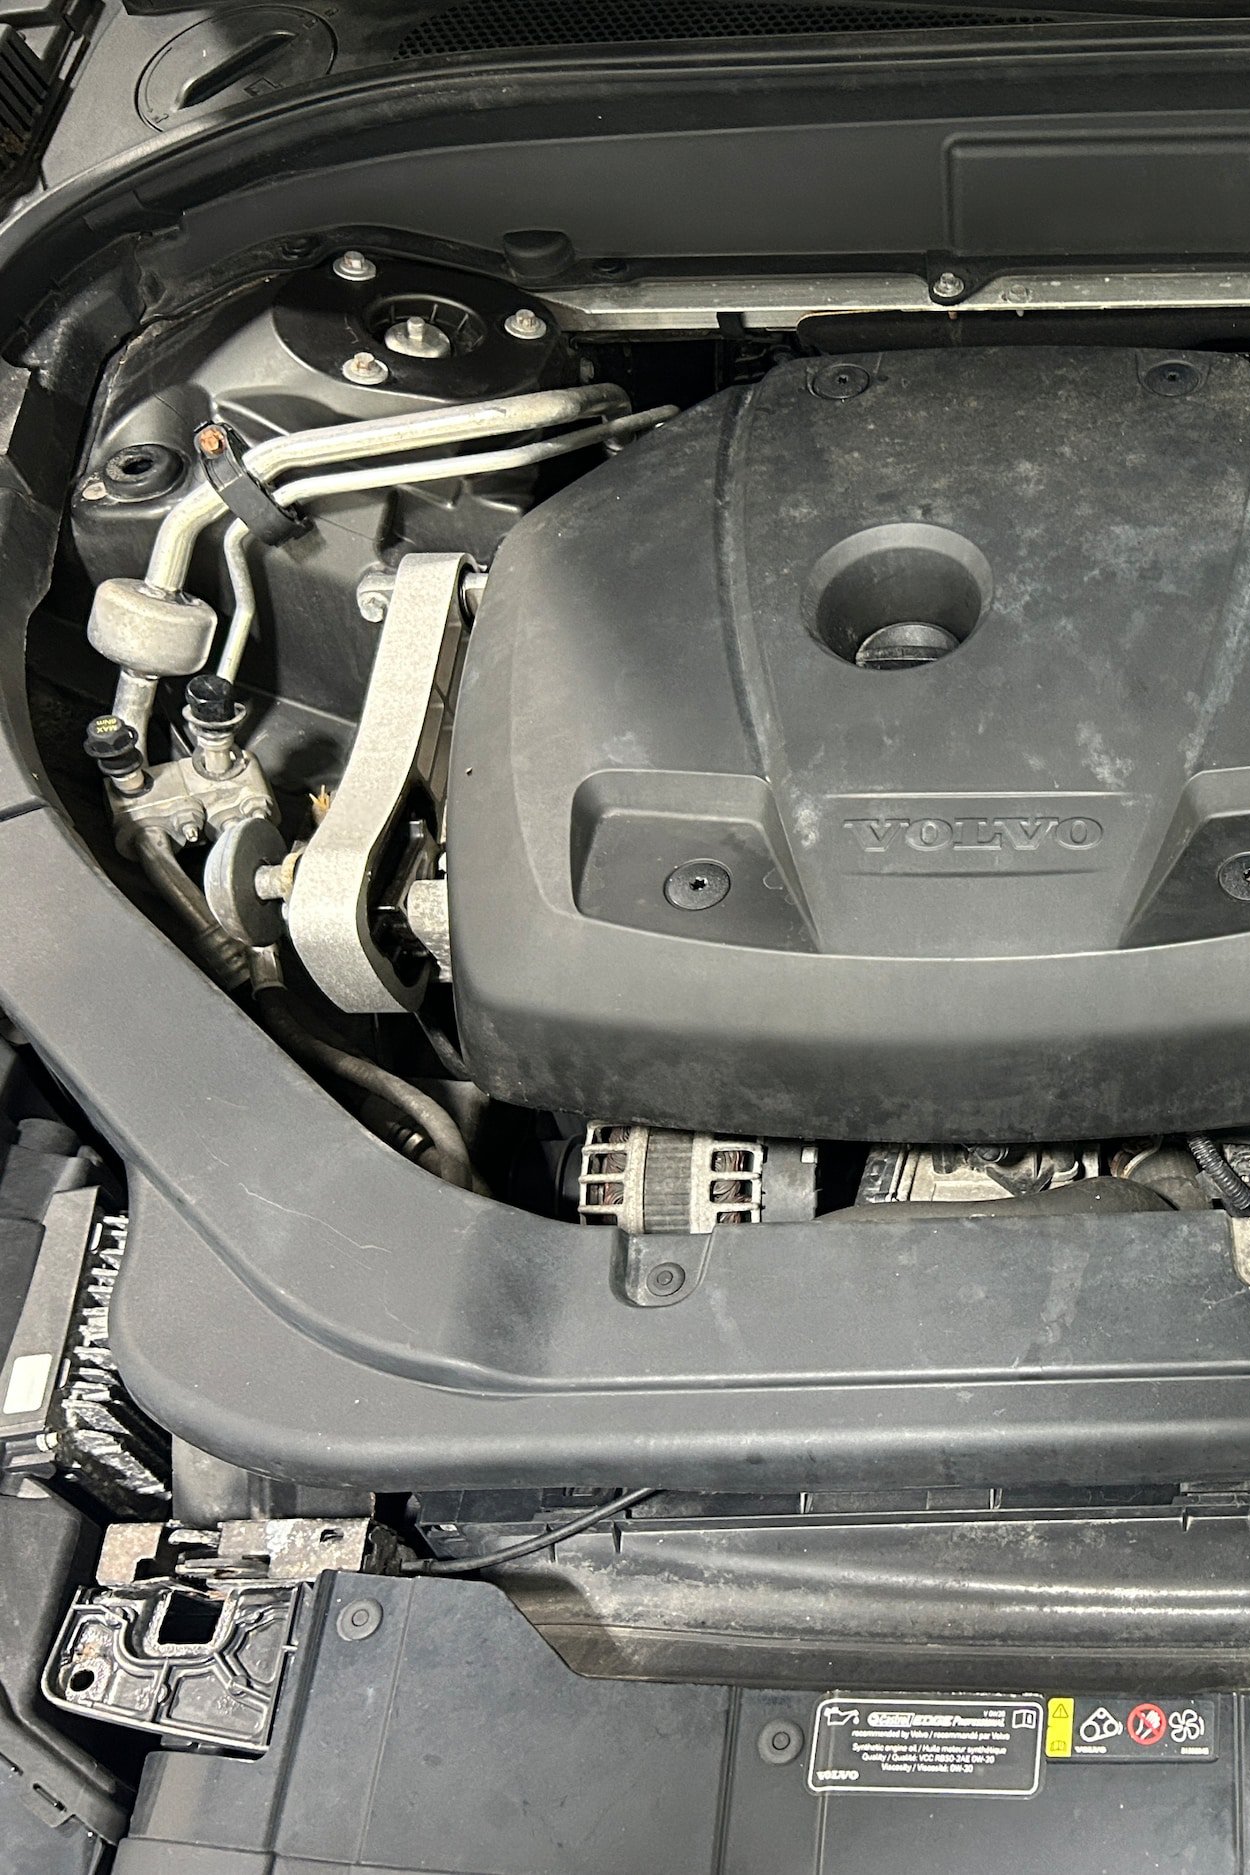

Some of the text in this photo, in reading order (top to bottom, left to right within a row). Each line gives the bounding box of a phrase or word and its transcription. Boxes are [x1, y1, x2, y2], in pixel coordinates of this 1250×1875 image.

[96, 725, 117, 733] MAX
[843, 817, 1103, 852] VOLVO
[851, 1729, 901, 1738] recommended
[901, 1730, 910, 1739] by
[910, 1730, 929, 1738] Volvo
[978, 1732, 991, 1741] par
[991, 1731, 1010, 1740] Volvo
[852, 1742, 885, 1752] Synthetic
[885, 1744, 908, 1753] engine
[908, 1744, 918, 1752] oil
[922, 1744, 940, 1753] Huile
[941, 1745, 966, 1753] moteur
[967, 1745, 1007, 1755] synthétique
[1074, 1746, 1107, 1754] VOLVO
[861, 1752, 886, 1762] Quality
[918, 1753, 934, 1762] VCC
[881, 1763, 912, 1773] Viscosity
[816, 1770, 859, 1780] VOLVO
